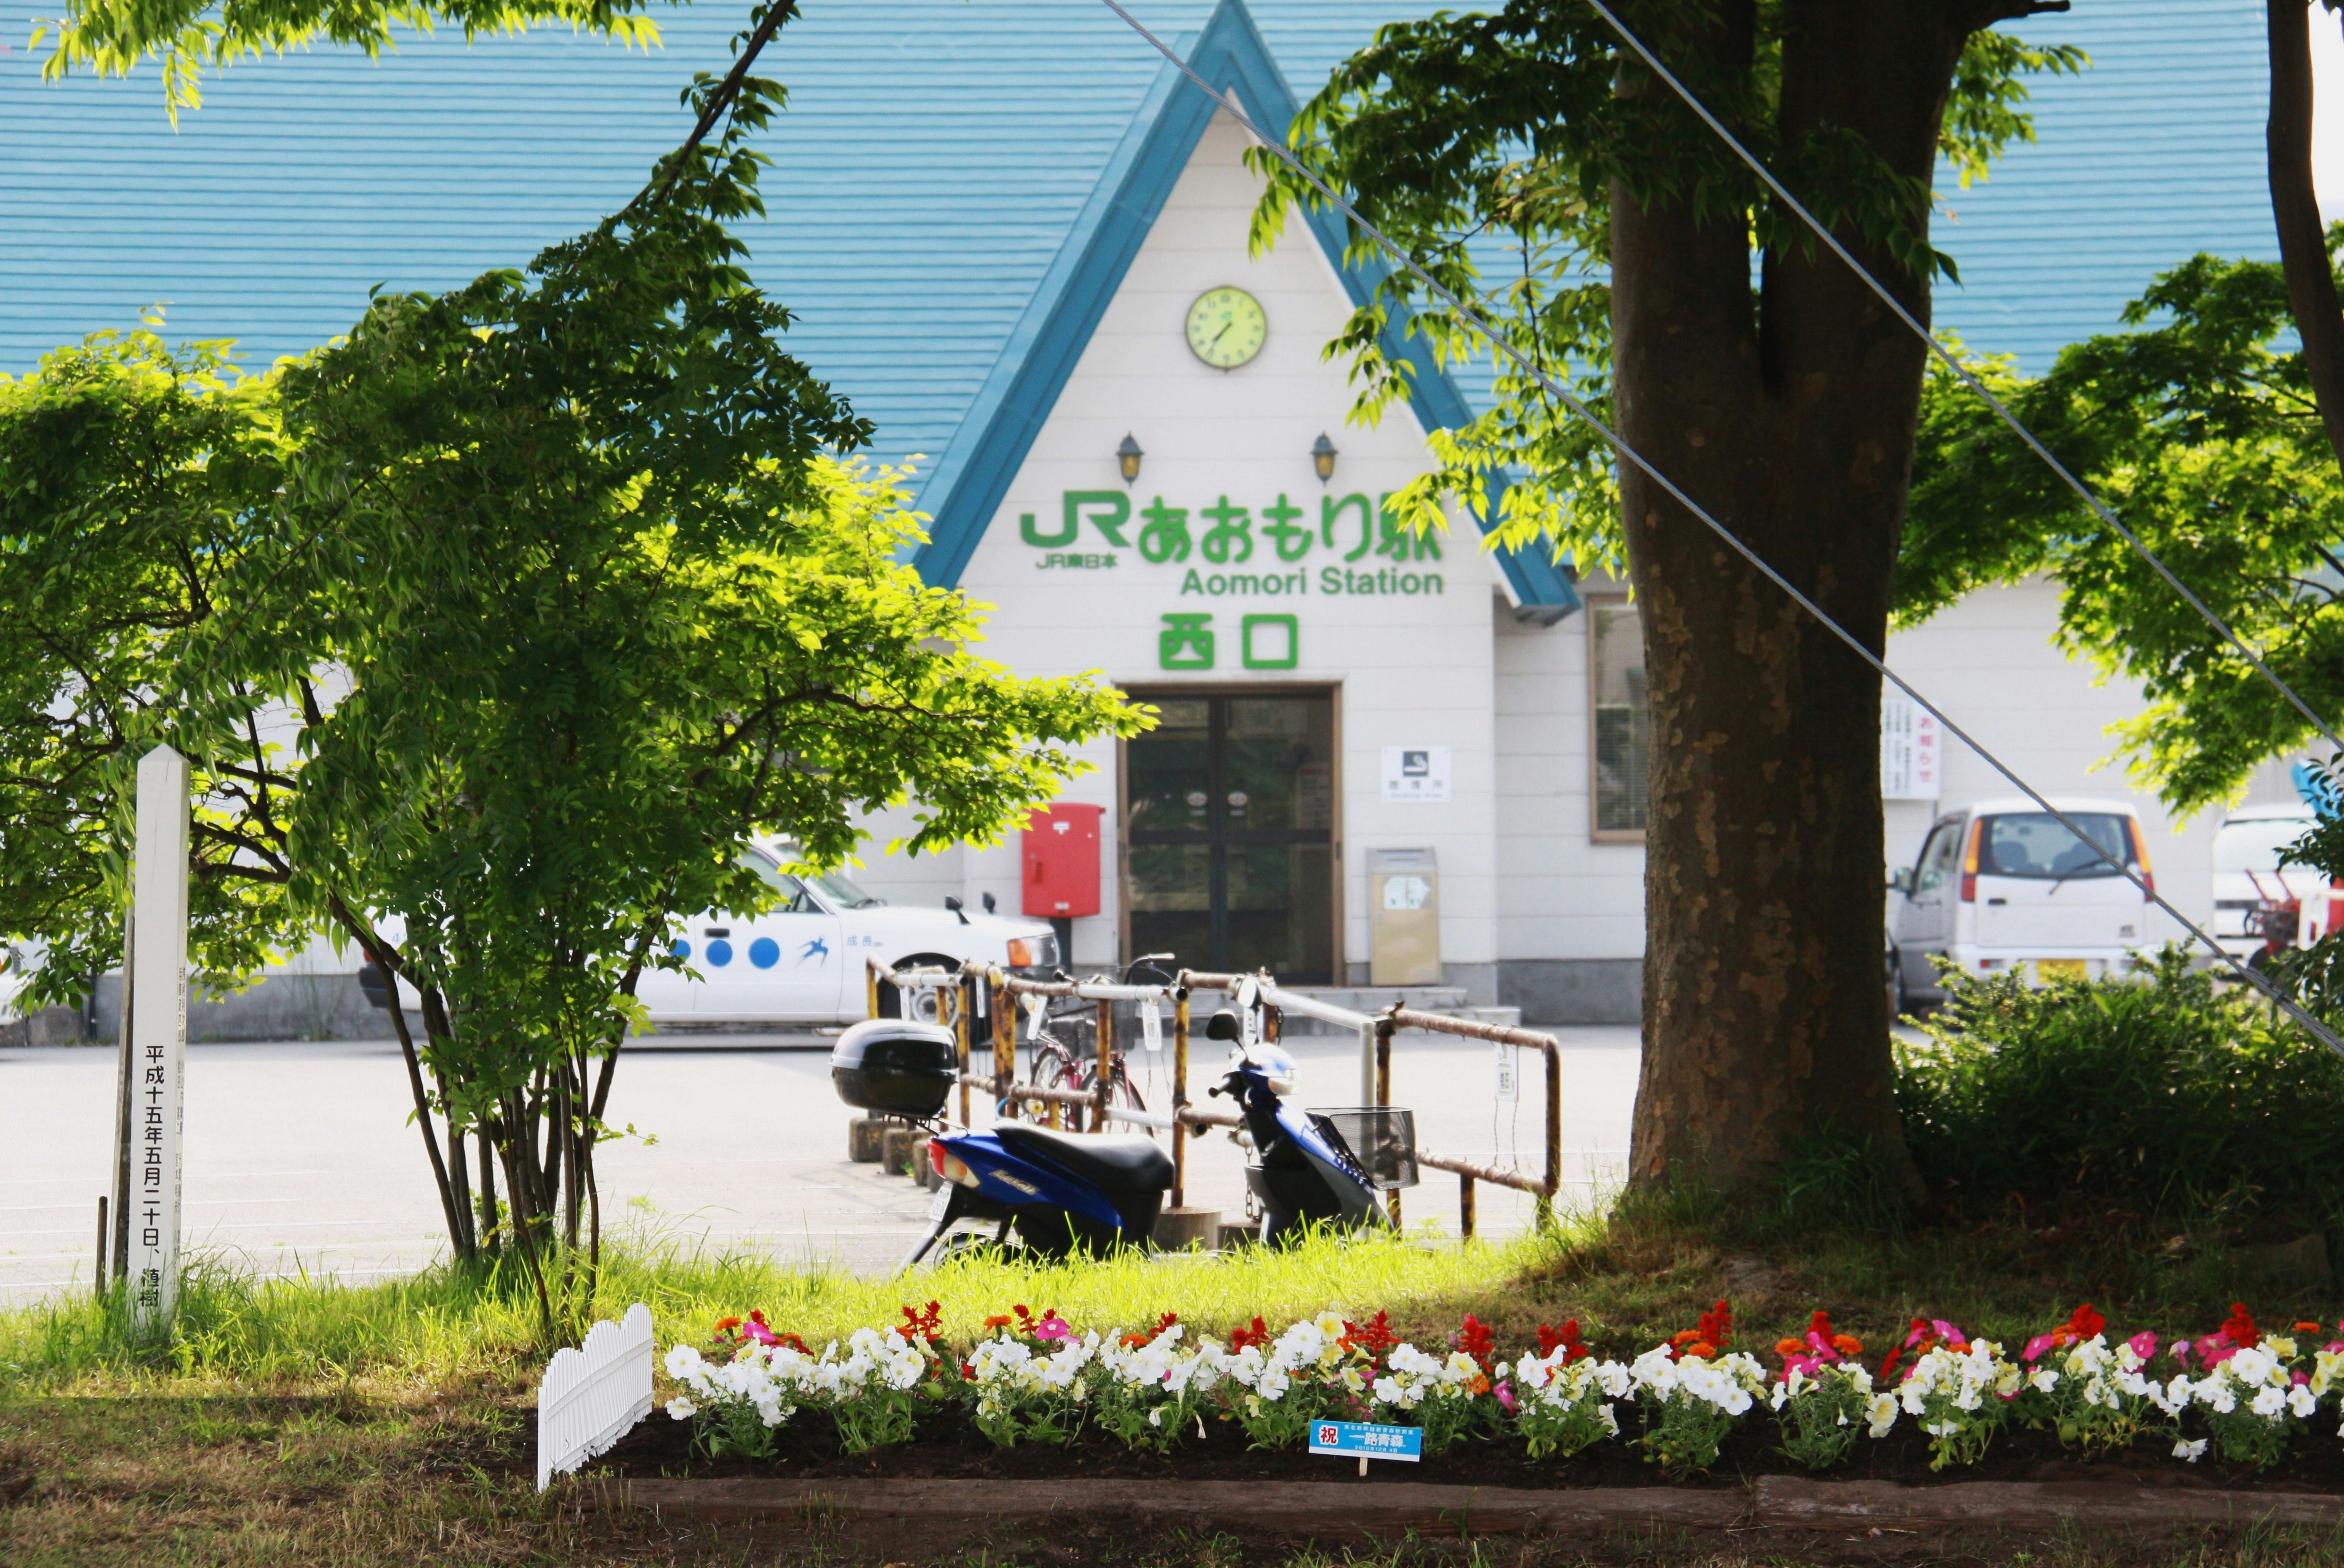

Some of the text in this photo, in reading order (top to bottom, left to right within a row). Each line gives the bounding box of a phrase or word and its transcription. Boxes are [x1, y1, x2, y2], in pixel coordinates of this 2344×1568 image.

[1020, 490, 1132, 548] JR
[1180, 566, 1444, 595] Aomori Station
[1159, 613, 1299, 670] 西口
[1320, 1426, 1337, 1444] 祝
[1349, 1432, 1403, 1447] 一路青森
